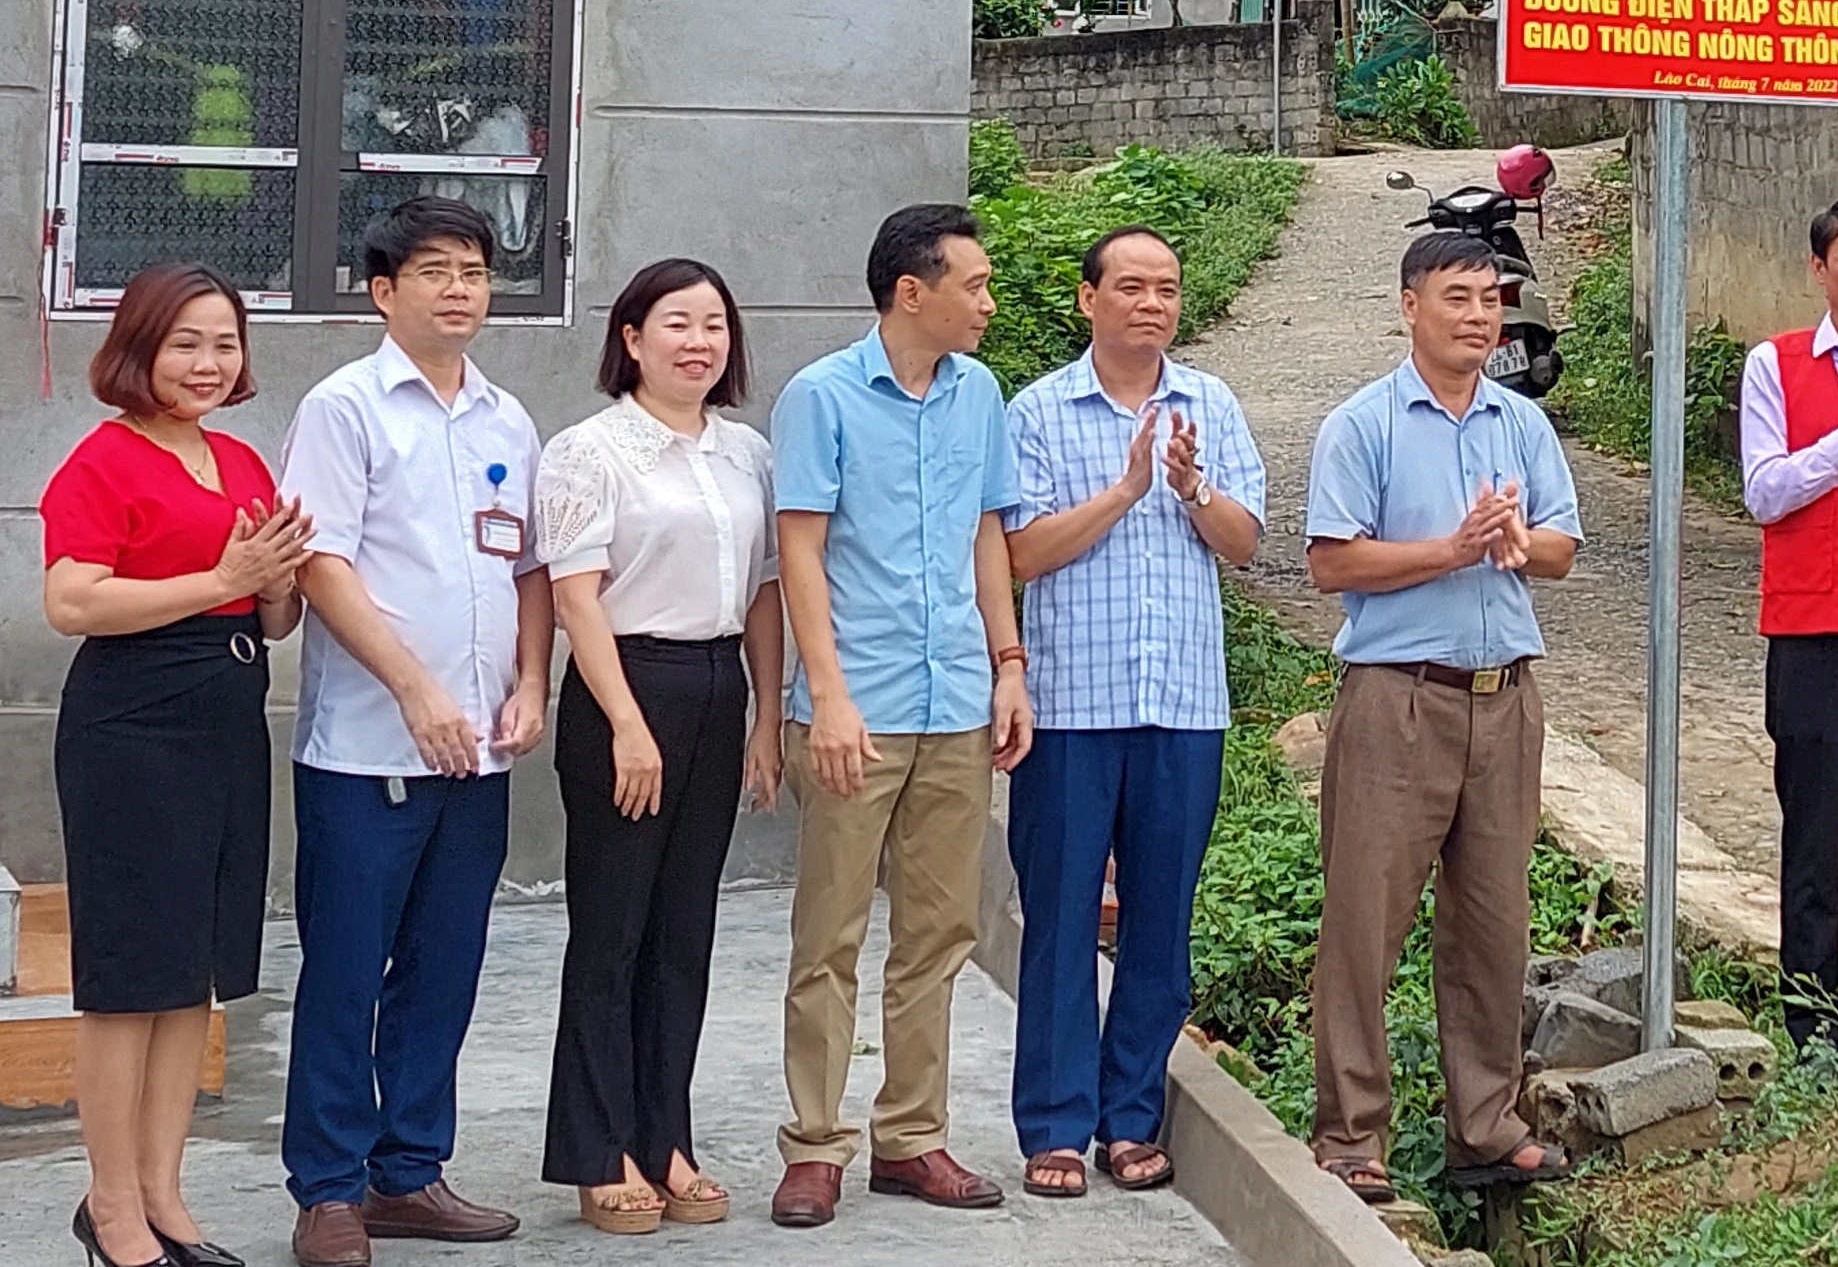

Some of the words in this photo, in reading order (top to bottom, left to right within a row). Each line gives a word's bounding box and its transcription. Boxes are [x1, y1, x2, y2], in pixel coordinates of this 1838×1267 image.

[1523, 21, 1590, 51] GIAO
[1597, 22, 1690, 57] THÔNG
[1698, 28, 1774, 62] NÔNG
[1685, 73, 1715, 90] Cai,
[1717, 76, 1758, 93] tháng
[1760, 77, 1771, 92] 7
[1773, 78, 1803, 92] năm
[1805, 78, 1838, 93] 2022
